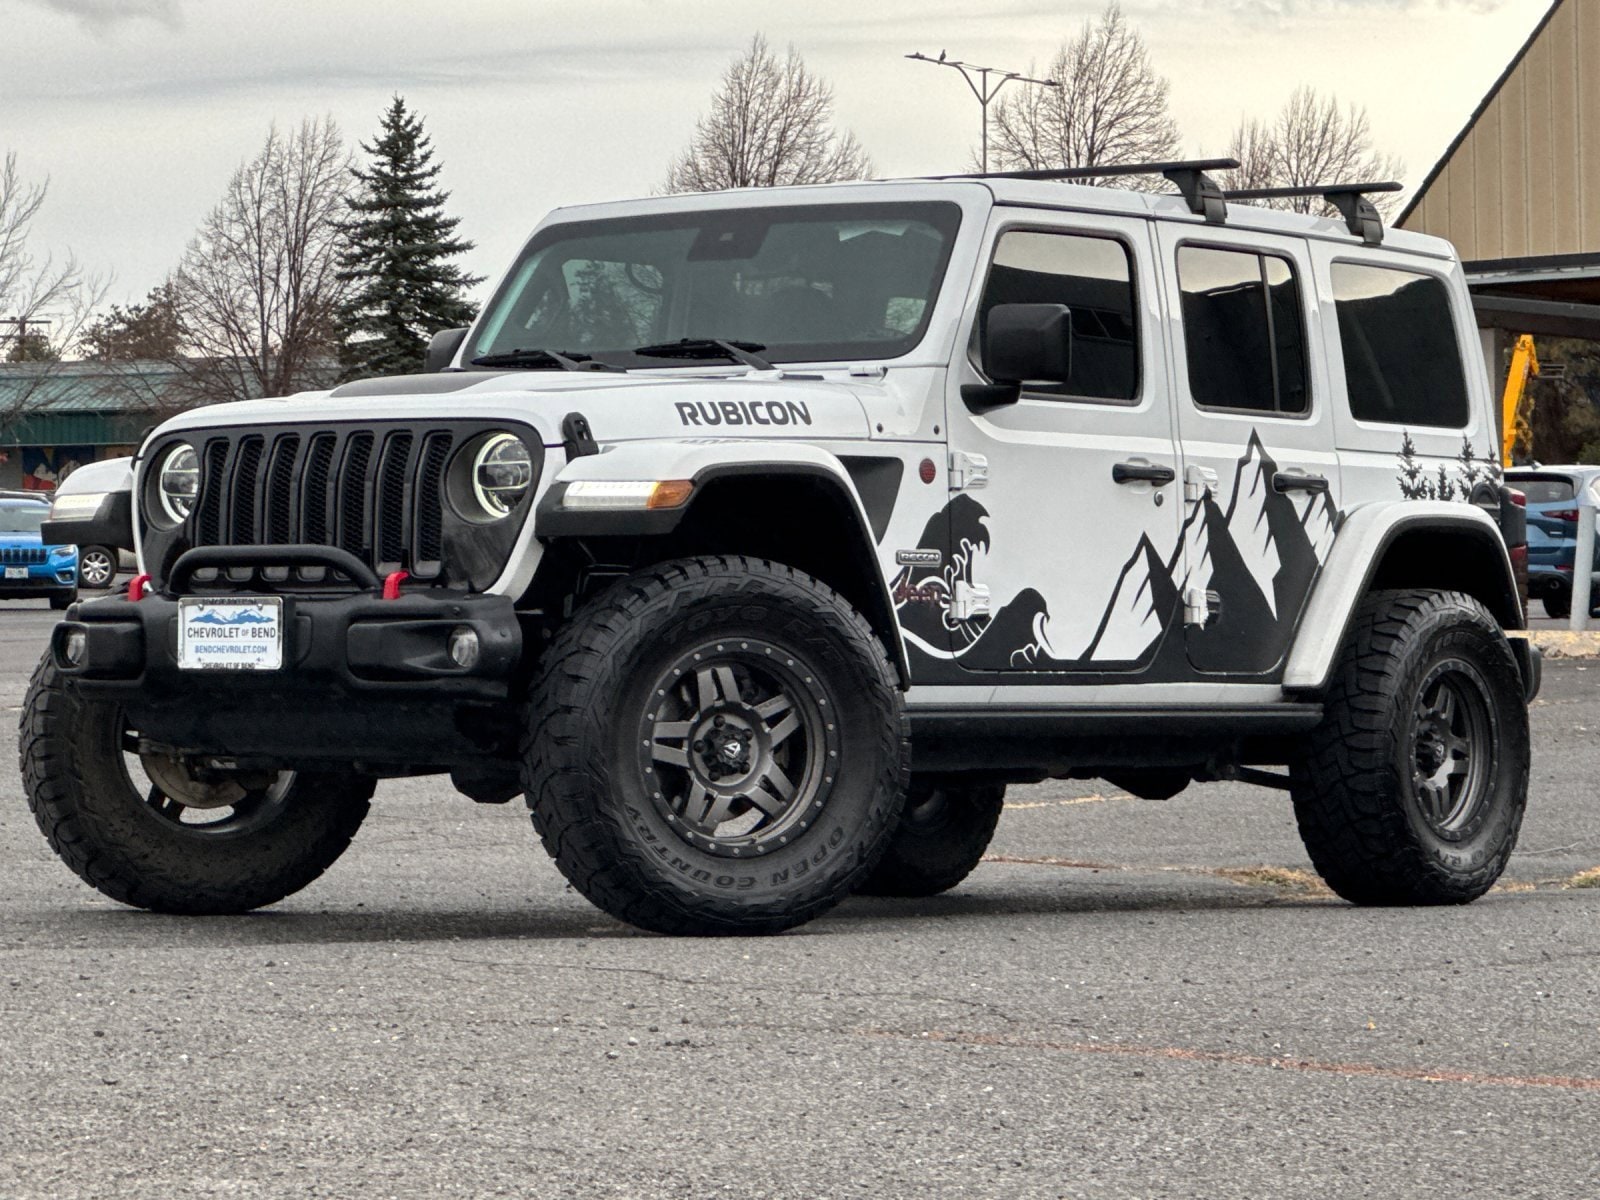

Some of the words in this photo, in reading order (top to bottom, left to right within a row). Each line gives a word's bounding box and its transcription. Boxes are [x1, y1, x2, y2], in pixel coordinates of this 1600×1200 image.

[674, 401, 812, 425] RUBICON
[900, 552, 939, 561] RECON
[187, 627, 240, 639] CHEVROLET
[241, 628, 250, 637] OF
[251, 627, 276, 638] BEND
[194, 645, 268, 654] BENDCHEVROLET.COM
[624, 803, 756, 890] COUNTRY
[770, 826, 845, 886] OPEN
